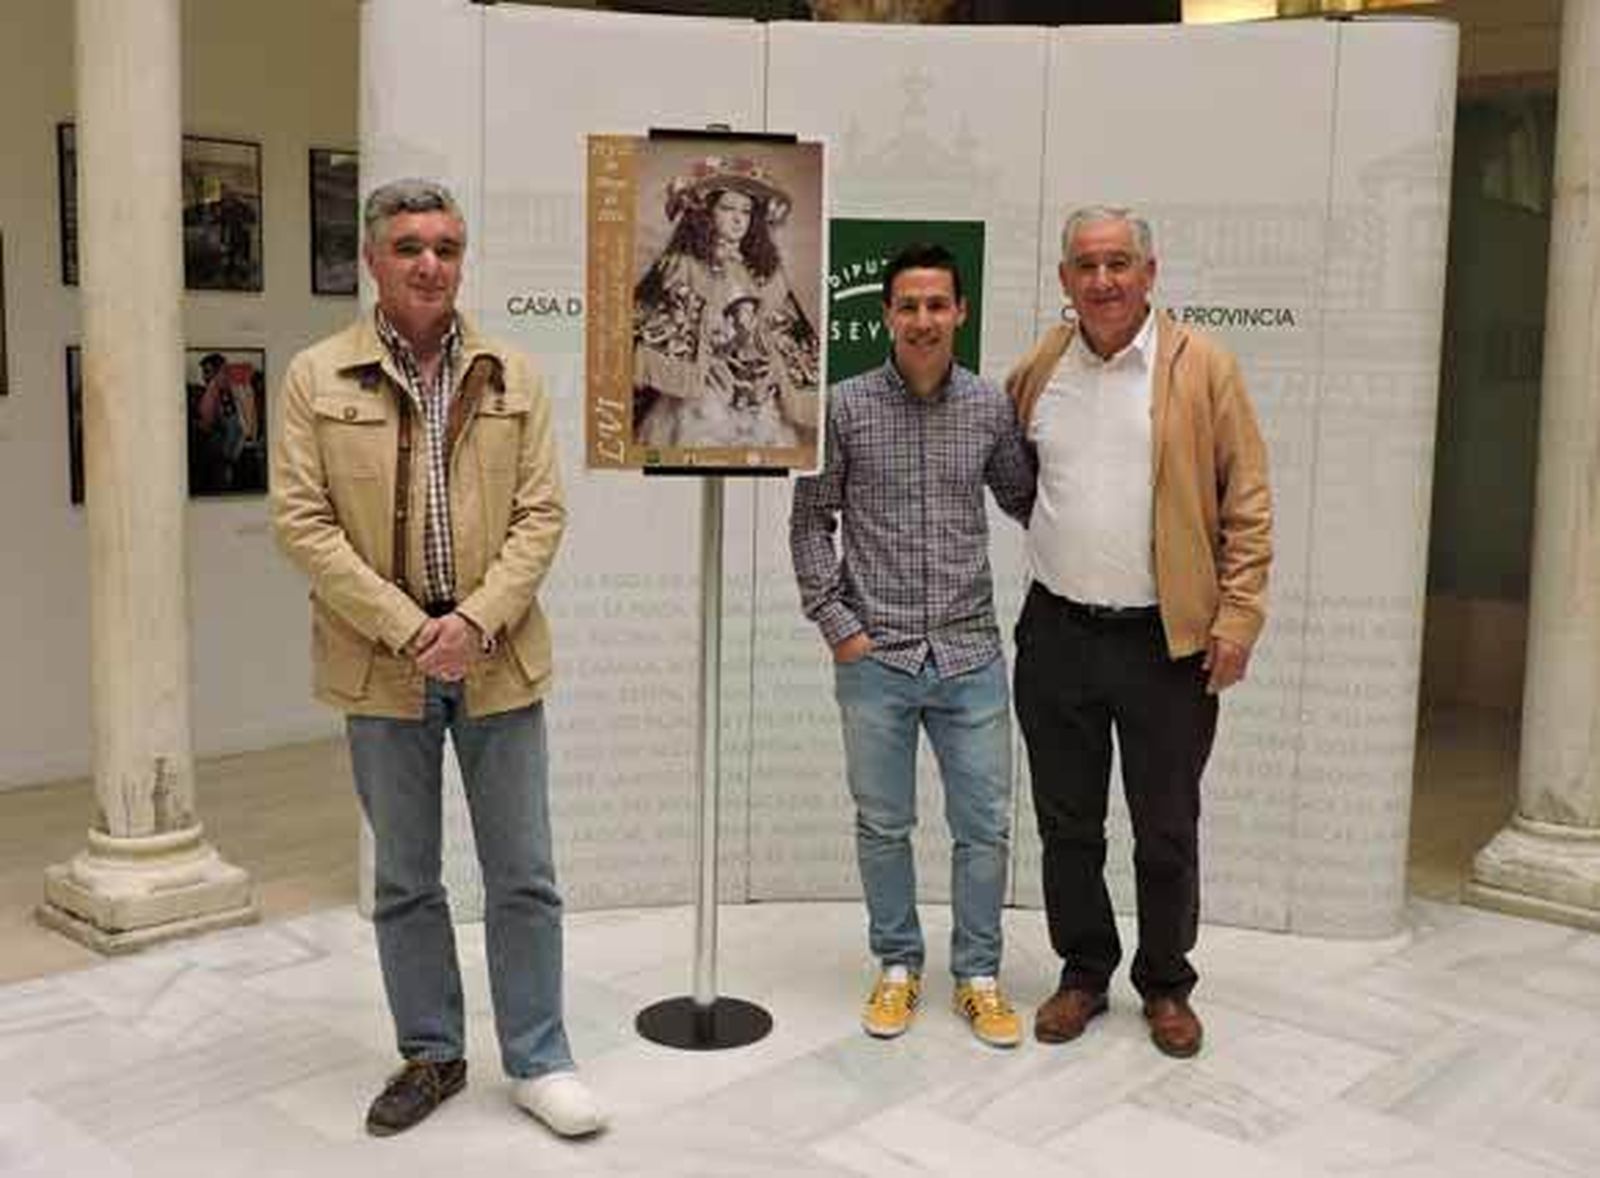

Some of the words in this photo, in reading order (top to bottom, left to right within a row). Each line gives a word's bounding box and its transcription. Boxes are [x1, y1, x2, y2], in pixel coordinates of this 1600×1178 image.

[827, 258, 887, 288] DIPU
[507, 296, 561, 315] CASA
[567, 297, 583, 316] D
[1182, 307, 1296, 327] PROVINCIA
[830, 320, 881, 341] SEV
